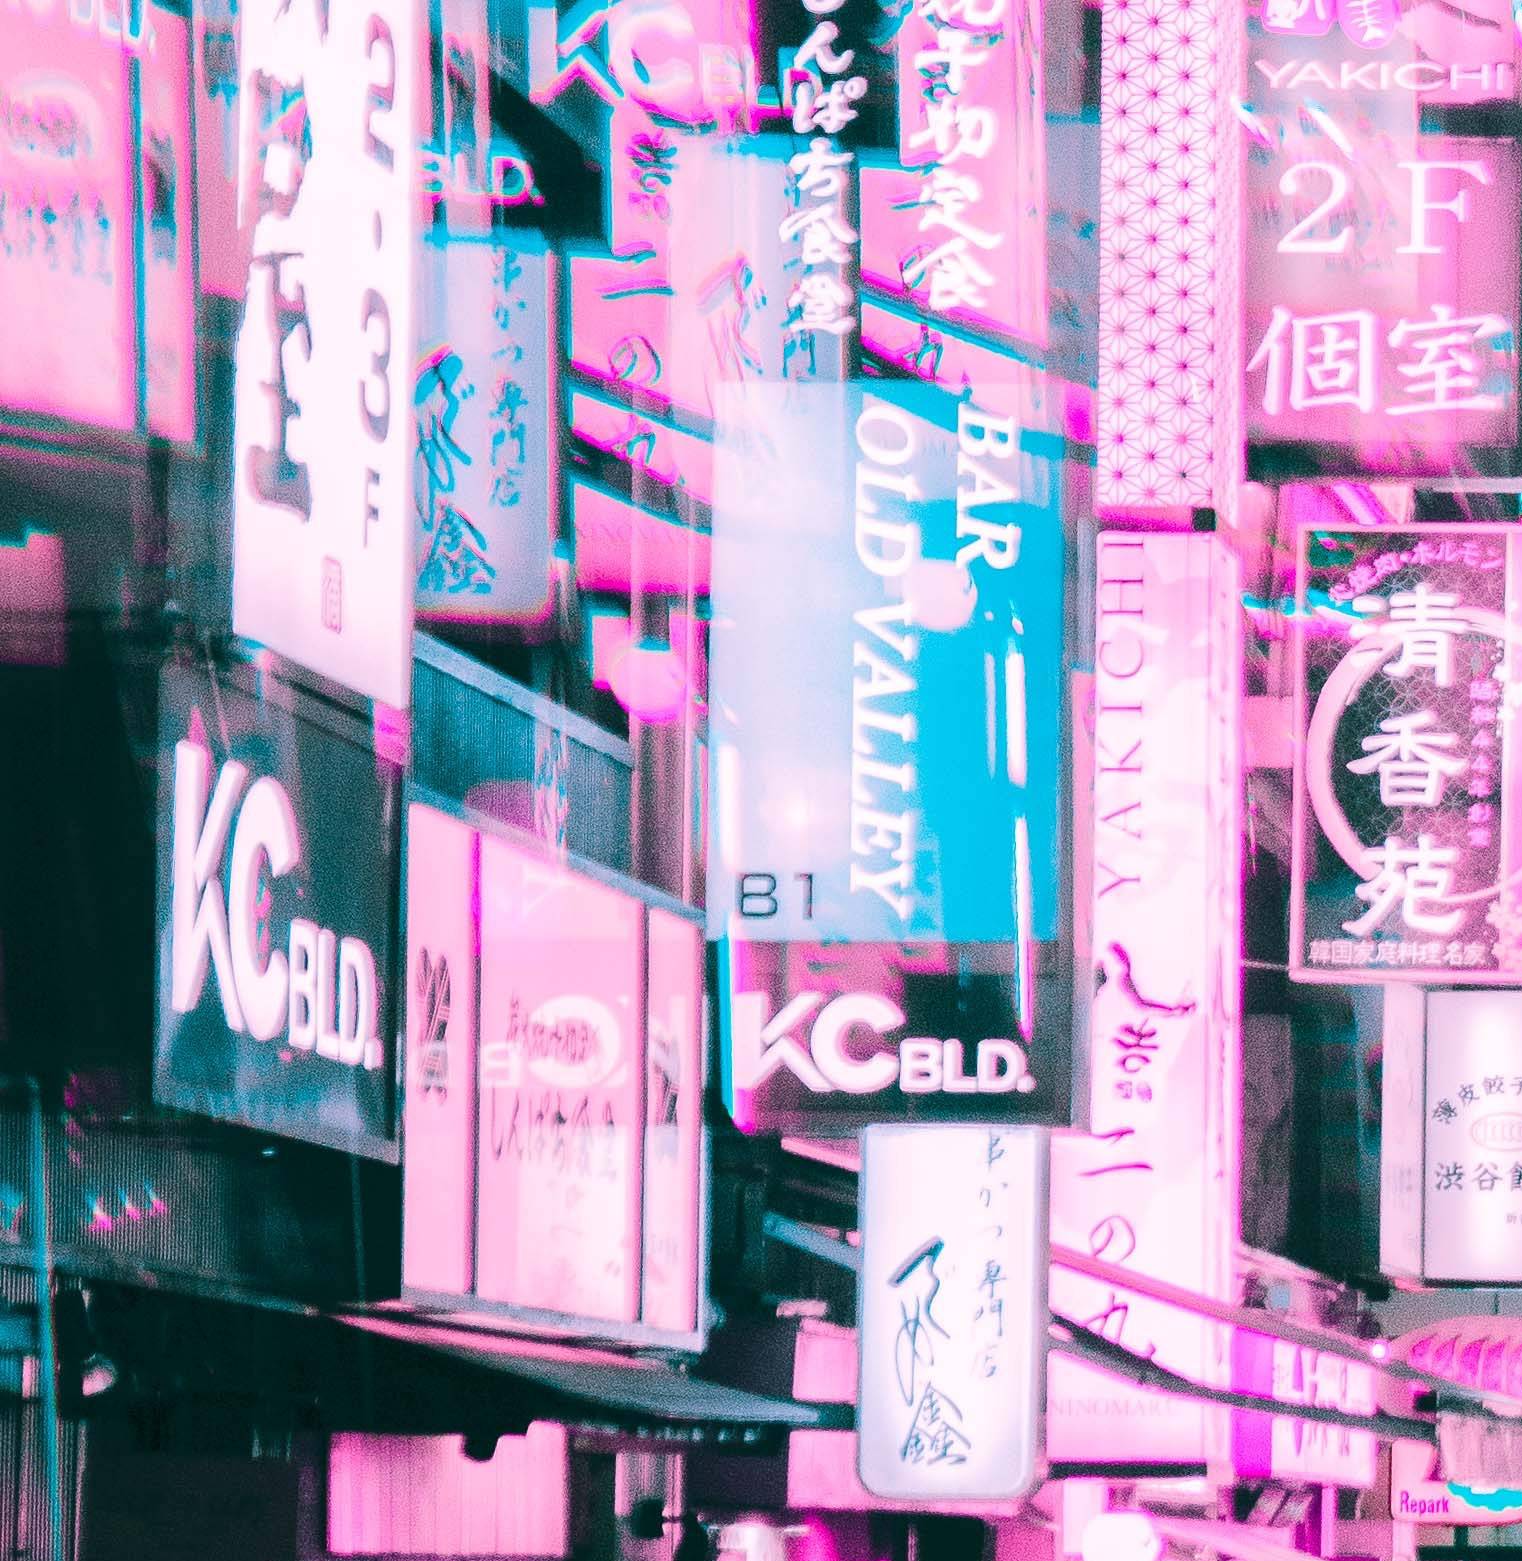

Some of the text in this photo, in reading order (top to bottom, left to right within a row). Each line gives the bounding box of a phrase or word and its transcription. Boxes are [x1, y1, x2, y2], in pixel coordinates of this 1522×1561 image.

[1253, 57, 1510, 92] YAKICHI
[779, 0, 867, 335] んぱち食堂
[1276, 161, 1495, 256] 2F
[1246, 304, 1511, 417] 個室
[957, 403, 1024, 570] BAR
[850, 409, 920, 919] OLD VALLEY
[1099, 537, 1146, 900] YAKICHI
[172, 740, 383, 1070] KC BLD.
[737, 872, 816, 920] B1
[734, 990, 906, 1095] KC
[899, 1037, 1037, 1095] BLD.
[1400, 1489, 1450, 1518] Repark
